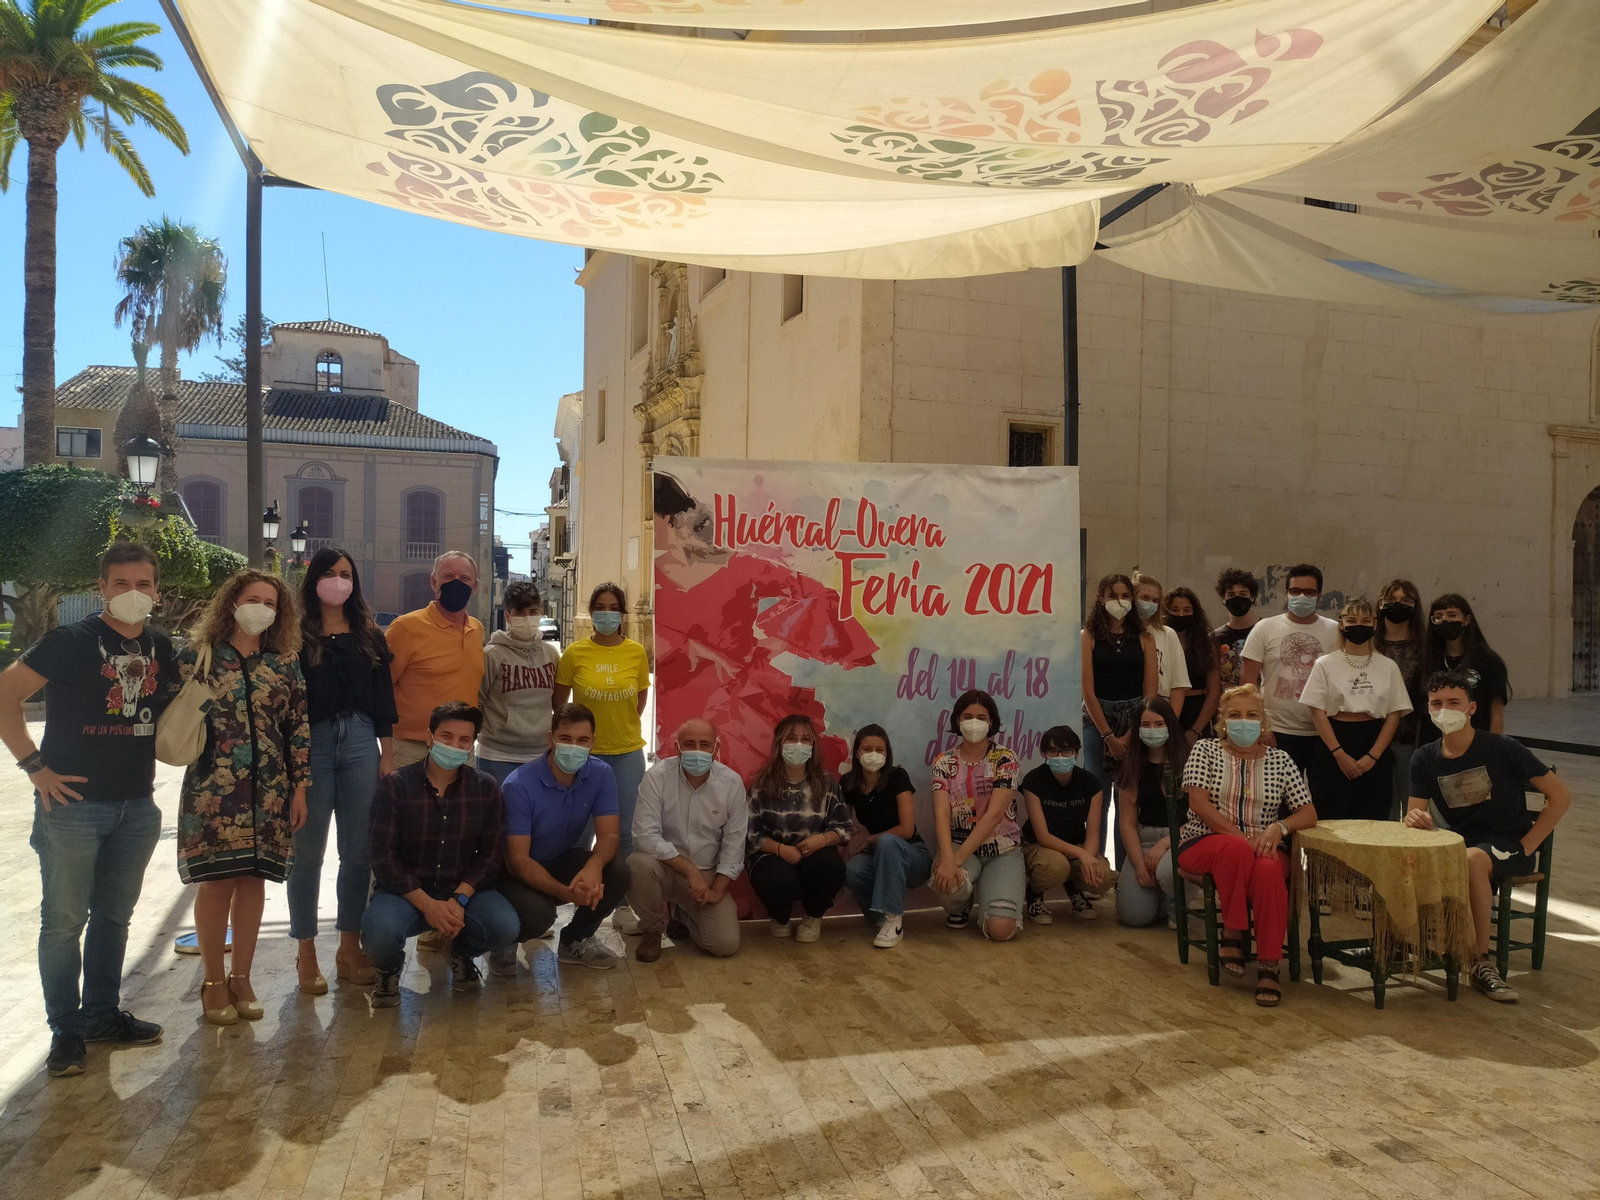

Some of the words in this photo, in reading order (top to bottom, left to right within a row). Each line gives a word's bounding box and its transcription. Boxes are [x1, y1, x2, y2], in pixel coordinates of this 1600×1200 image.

[713, 493, 947, 550] Huércal-Overa
[835, 551, 950, 619] Feria
[964, 562, 1053, 616] 2021
[500, 661, 558, 694] HARVAR
[595, 663, 619, 673] SMILE
[896, 647, 940, 700] del
[946, 658, 976, 698] 14
[987, 649, 1016, 700] al
[1023, 657, 1050, 698] 18
[584, 684, 637, 702] CONTAGIOUS
[605, 676, 615, 686] IS
[82, 725, 97, 735] POR
[98, 725, 108, 735] UN
[109, 724, 134, 735] PUÑADO
